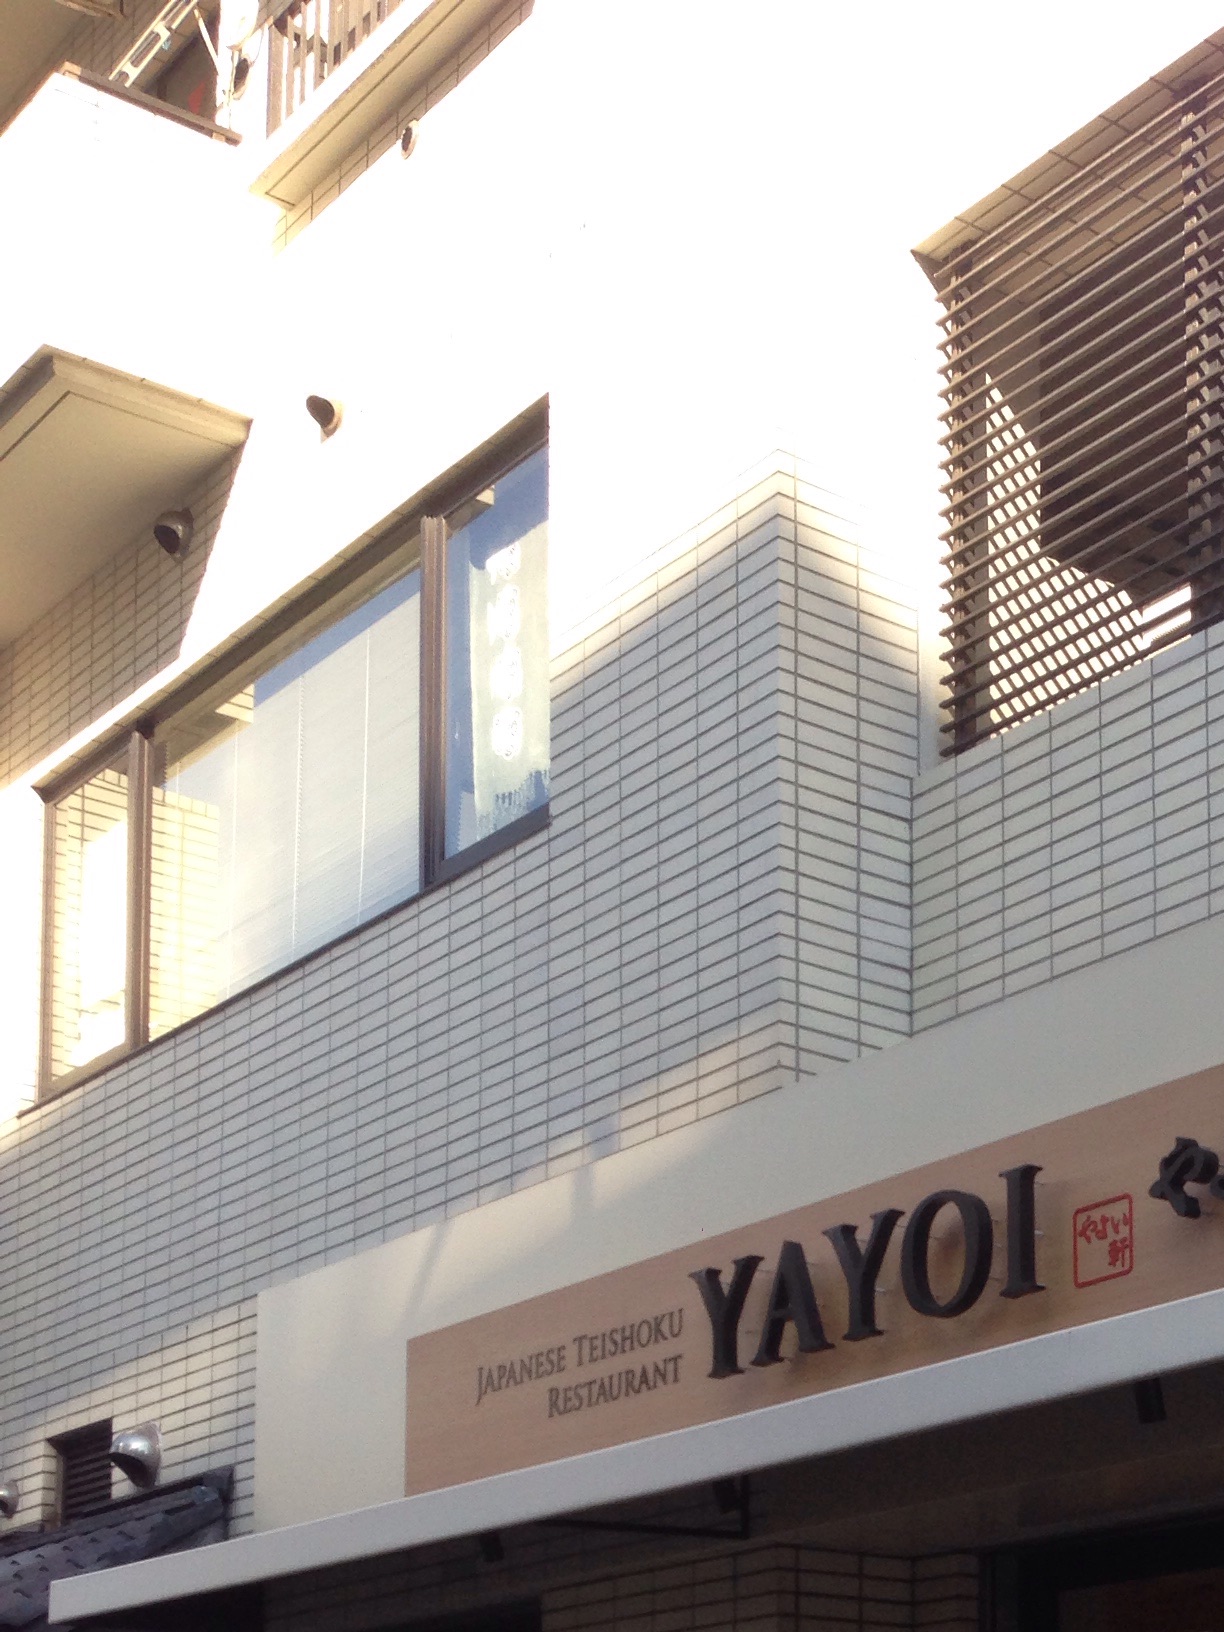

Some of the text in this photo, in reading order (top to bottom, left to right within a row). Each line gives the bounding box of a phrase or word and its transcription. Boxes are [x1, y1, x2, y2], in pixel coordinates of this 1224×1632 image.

[687, 1163, 1047, 1380] YAYOI
[475, 1308, 684, 1406] JAPANESE TEISHOKU
[547, 1353, 684, 1418] RESTAURANT
